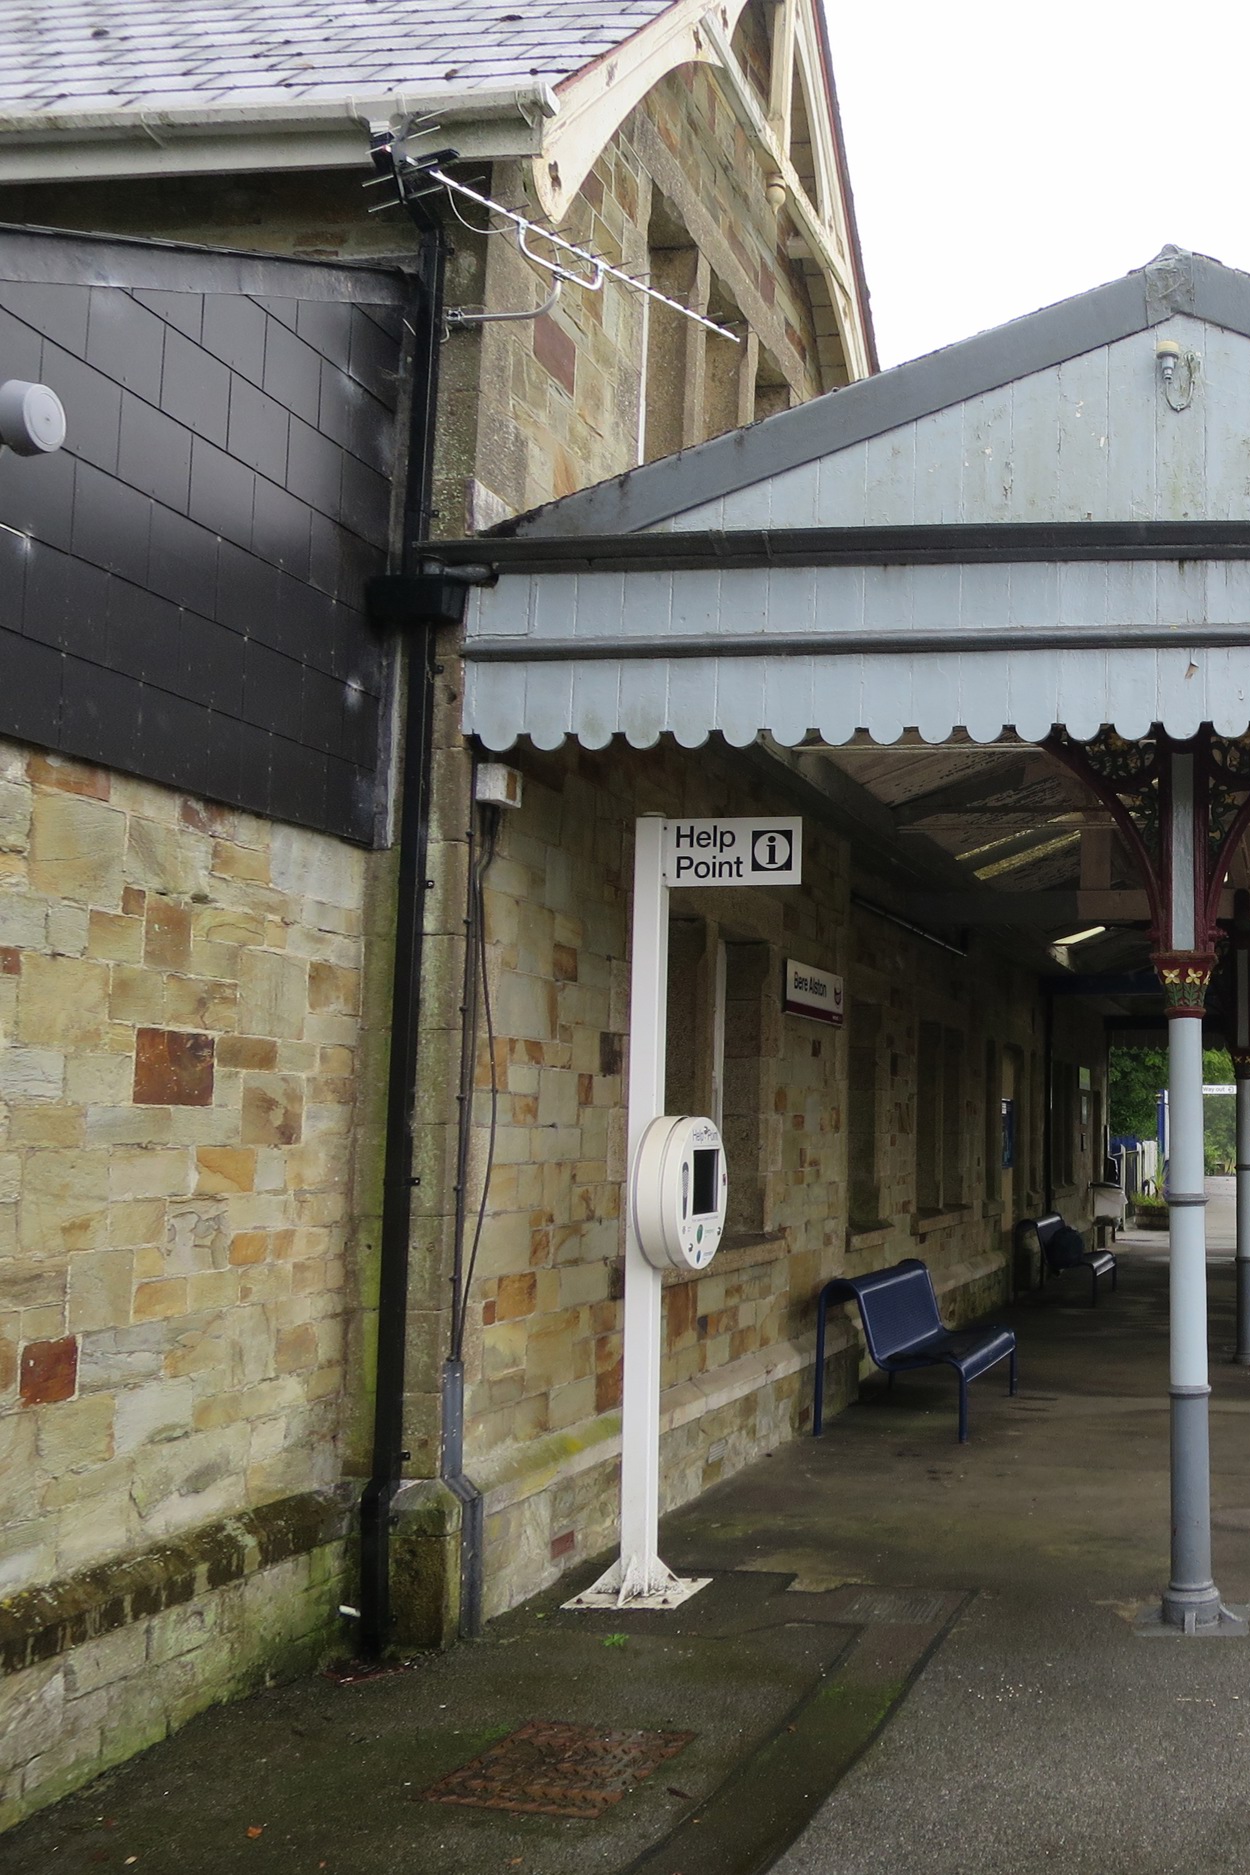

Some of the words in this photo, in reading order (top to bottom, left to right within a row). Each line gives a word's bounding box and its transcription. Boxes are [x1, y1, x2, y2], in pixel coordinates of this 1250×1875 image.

[675, 825, 736, 853] Help
[676, 855, 744, 879] Point
[793, 971, 808, 992] Bere
[809, 976, 827, 998] Alston
